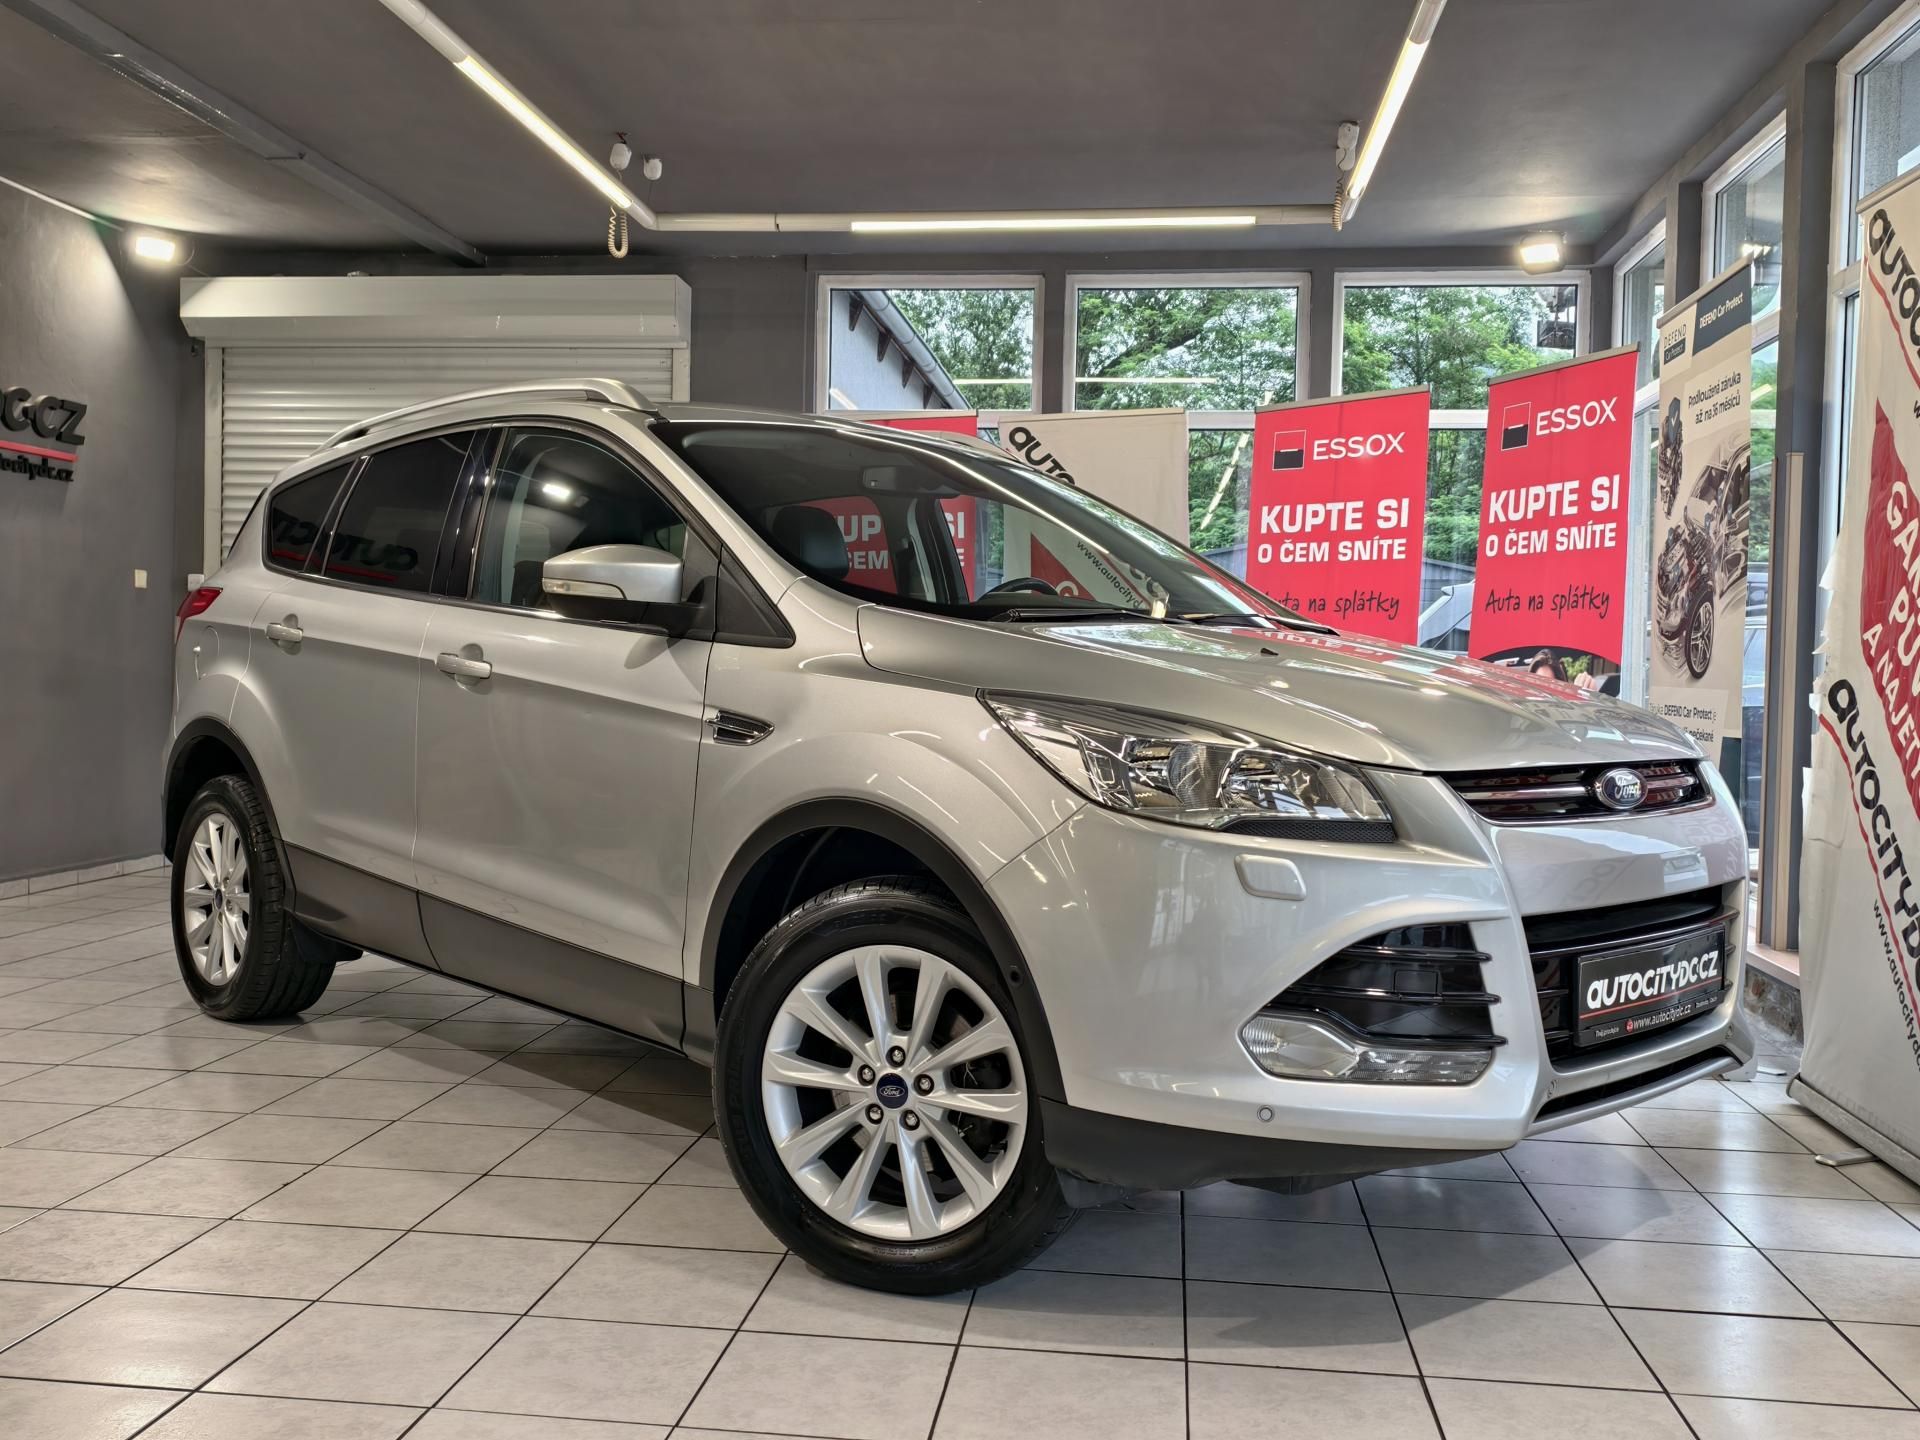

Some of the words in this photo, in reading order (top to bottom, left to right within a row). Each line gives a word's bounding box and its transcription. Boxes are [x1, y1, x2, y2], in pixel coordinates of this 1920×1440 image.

[1664, 323, 1687, 349] DEFEND
[1535, 397, 1618, 436] ESSOX
[1313, 431, 1406, 461] ESSOX
[1260, 501, 1364, 535] KUPTE
[1376, 498, 1410, 530] SI
[1488, 480, 1580, 525] KUPTE
[1590, 474, 1620, 513] SI
[1257, 543, 1272, 564] O
[1279, 536, 1330, 563] ČEM
[1337, 535, 1407, 562] SNÍTE
[1485, 534, 1498, 557] O
[1504, 527, 1548, 556] ČEM
[1555, 522, 1617, 552] SNÍTE
[1308, 598, 1326, 613] na
[1333, 590, 1400, 621] splátky
[1484, 588, 1522, 613] Auta
[1527, 595, 1545, 611] na
[1550, 583, 1610, 619] splátky
